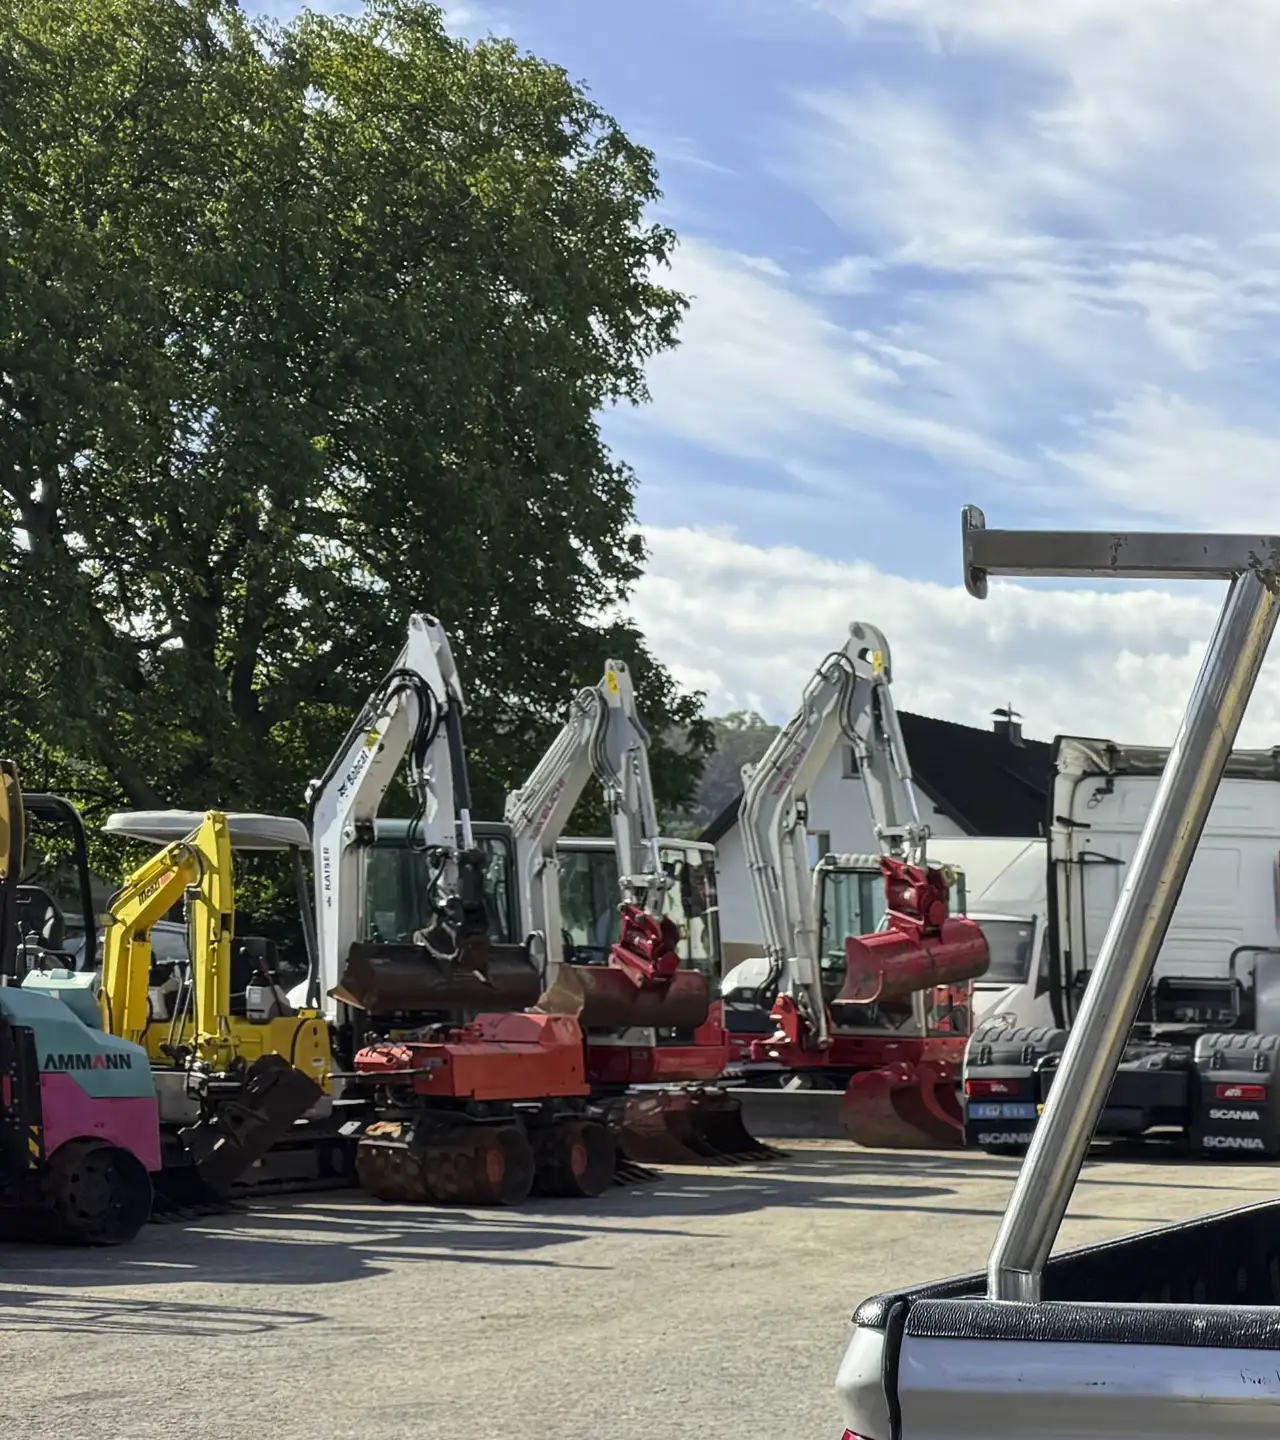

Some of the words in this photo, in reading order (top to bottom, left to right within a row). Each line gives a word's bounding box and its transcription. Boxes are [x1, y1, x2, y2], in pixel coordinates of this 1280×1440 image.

[346, 749, 369, 787] Bobcat
[323, 847, 331, 891] KAISER
[43, 1053, 133, 1071] AMMANN
[1209, 1108, 1260, 1121] SCANIA
[1202, 1136, 1265, 1149] SCANIA
